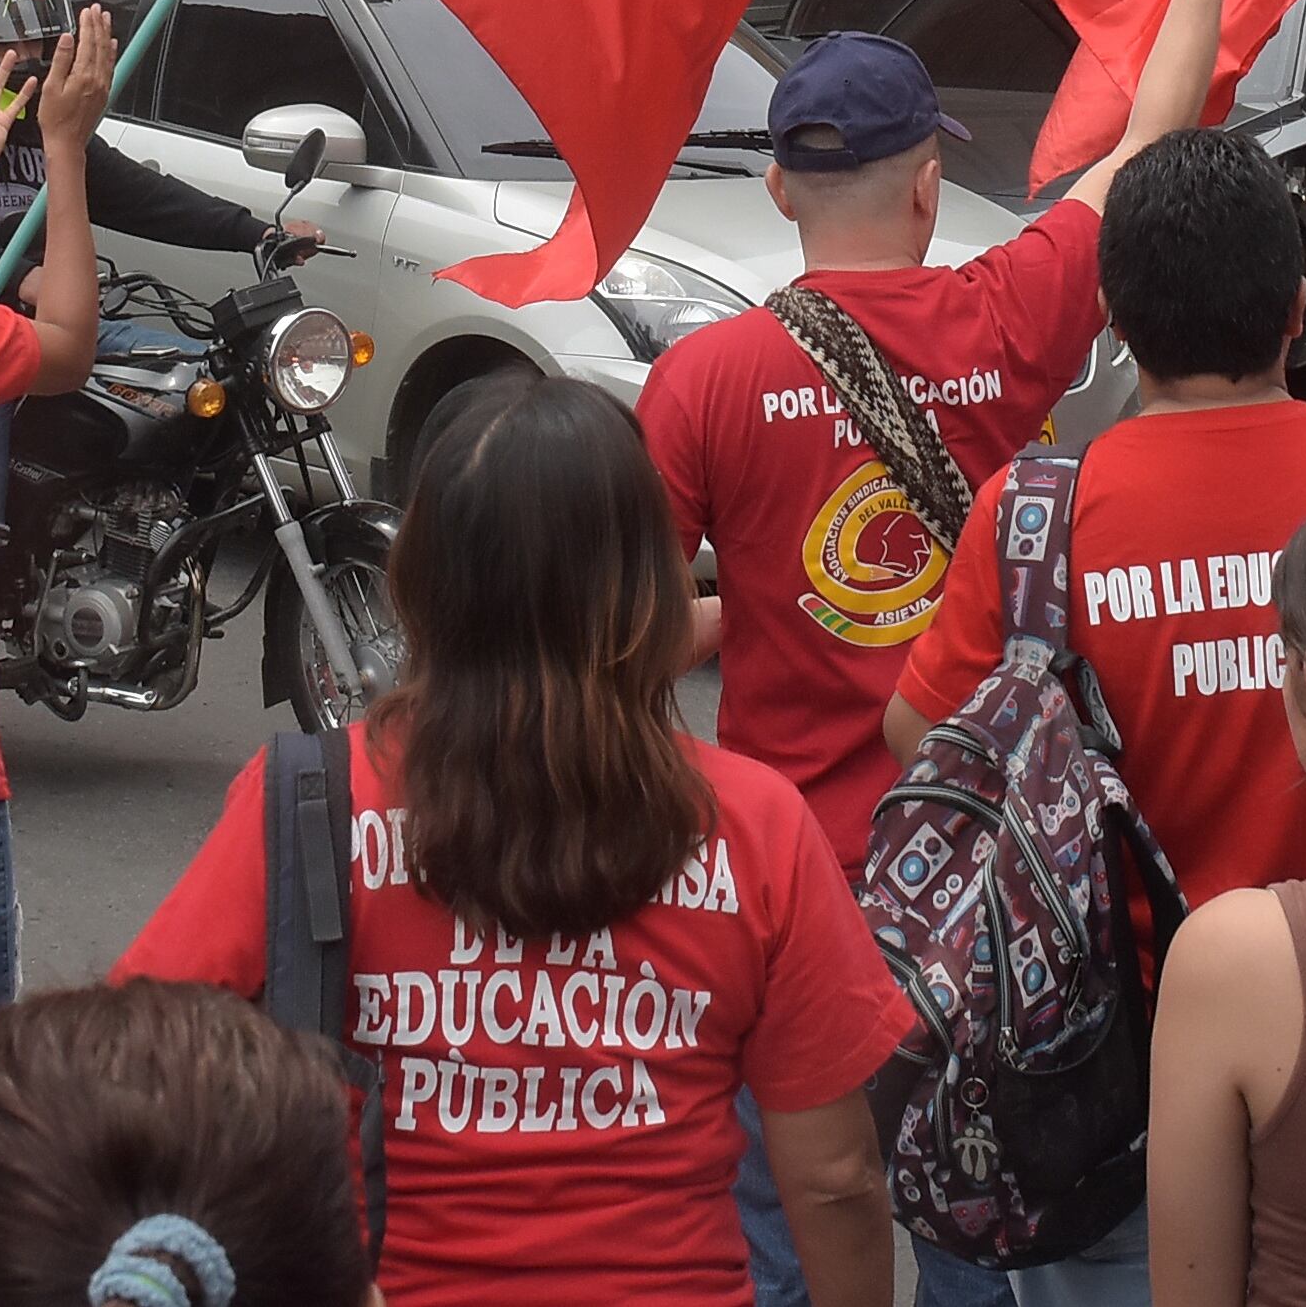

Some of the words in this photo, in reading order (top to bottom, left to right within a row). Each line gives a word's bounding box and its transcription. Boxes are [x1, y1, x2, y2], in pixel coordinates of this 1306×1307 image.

[3, 143, 46, 184] YOR
[763, 387, 818, 423] POR
[858, 506, 878, 525] DEL
[1083, 566, 1157, 626] POR
[1160, 558, 1205, 615] LA
[874, 597, 933, 626] ASIEVA
[1172, 633, 1286, 698] PUBLIC
